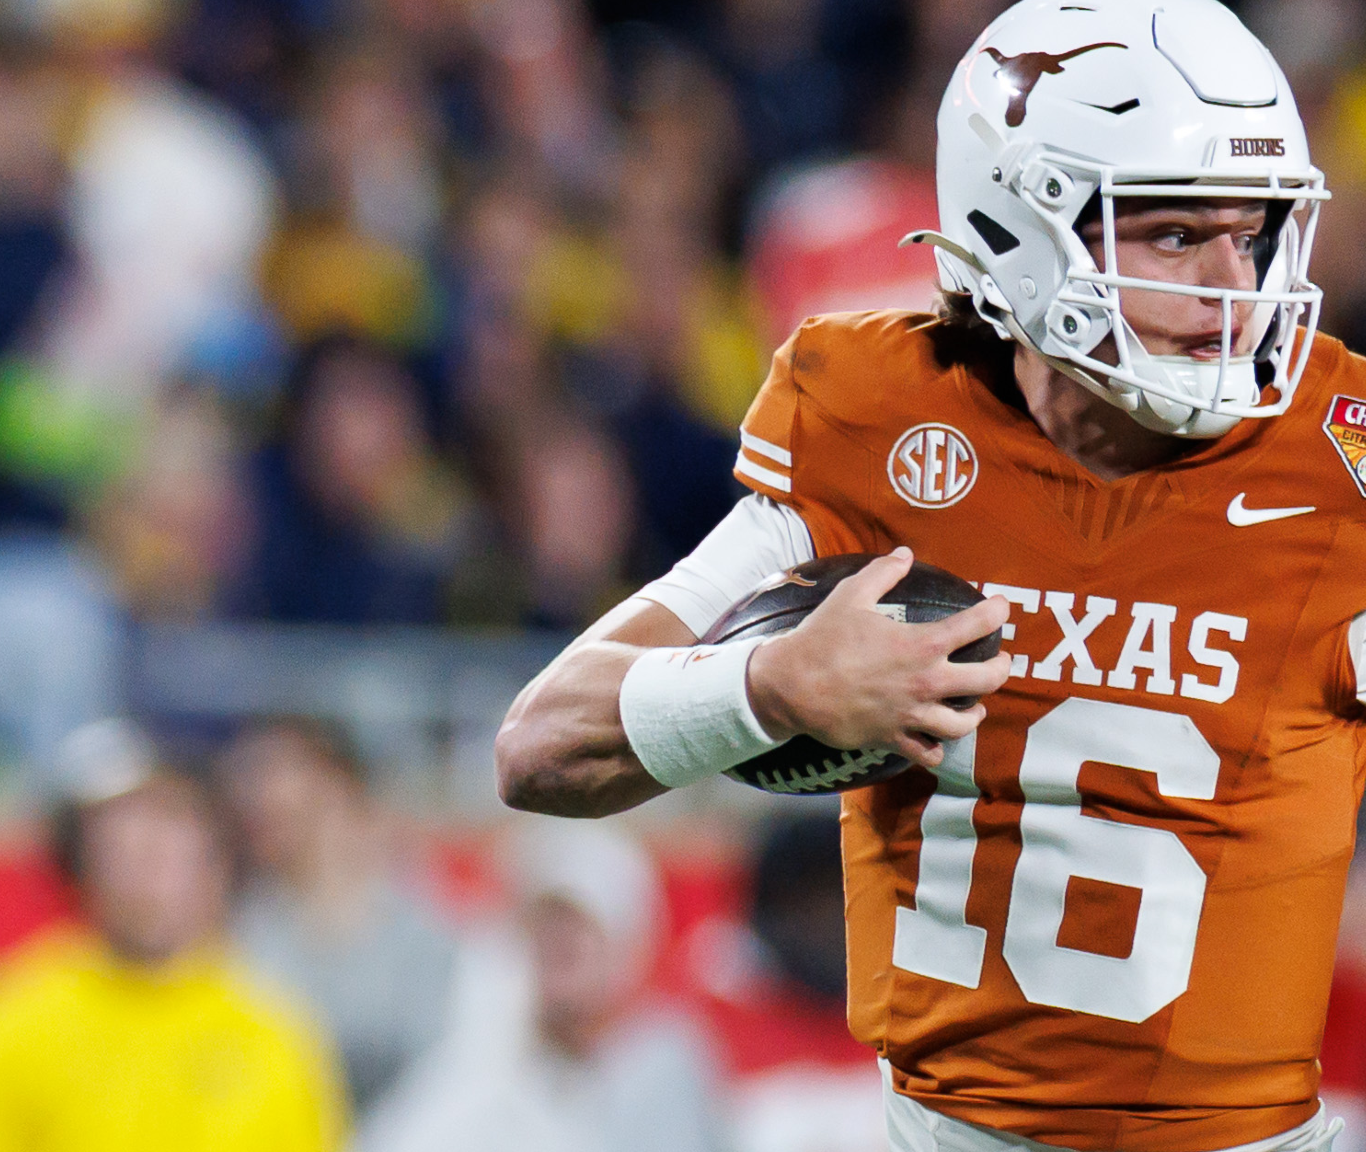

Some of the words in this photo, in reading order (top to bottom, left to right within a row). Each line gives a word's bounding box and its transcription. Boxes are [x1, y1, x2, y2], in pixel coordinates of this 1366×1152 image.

[1229, 138, 1286, 157] HORNS
[897, 429, 970, 501] SEC
[968, 581, 1248, 704] EXAS
[892, 696, 1221, 1024] 16
